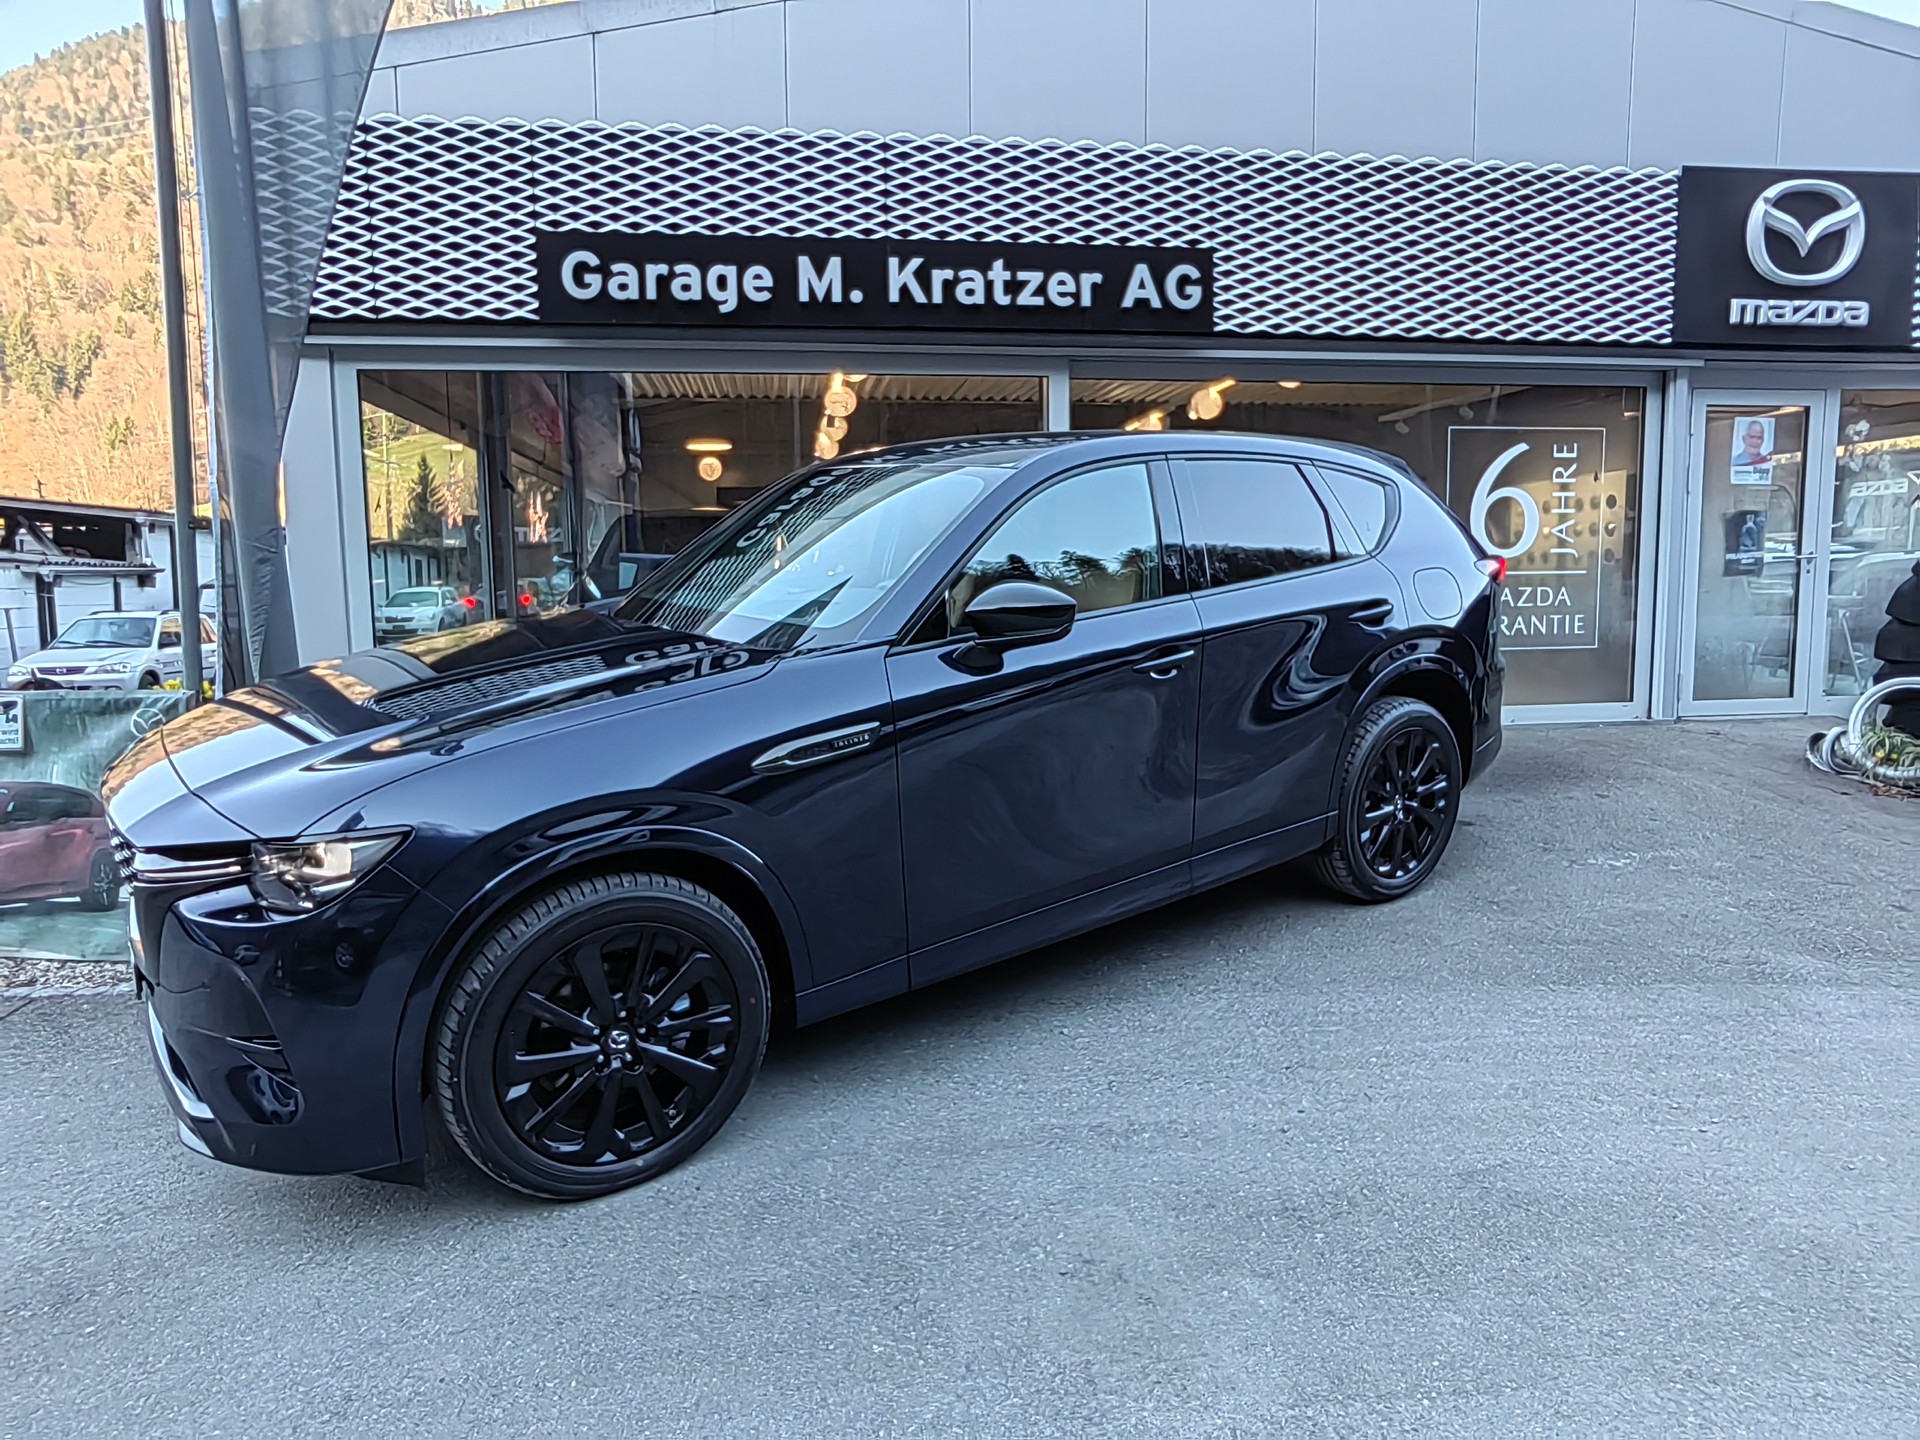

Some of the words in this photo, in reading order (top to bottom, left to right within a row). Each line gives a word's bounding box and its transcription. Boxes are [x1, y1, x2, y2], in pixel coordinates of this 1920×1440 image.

[561, 250, 774, 314] Garage
[797, 255, 864, 303] M.
[887, 256, 1103, 308] Kratzer
[1120, 263, 1203, 311] AG
[1469, 442, 1540, 559] 6
[1550, 442, 1579, 559] JAHRE
[1500, 586, 1572, 608] AZDA
[1500, 614, 1585, 636] RANTIE
